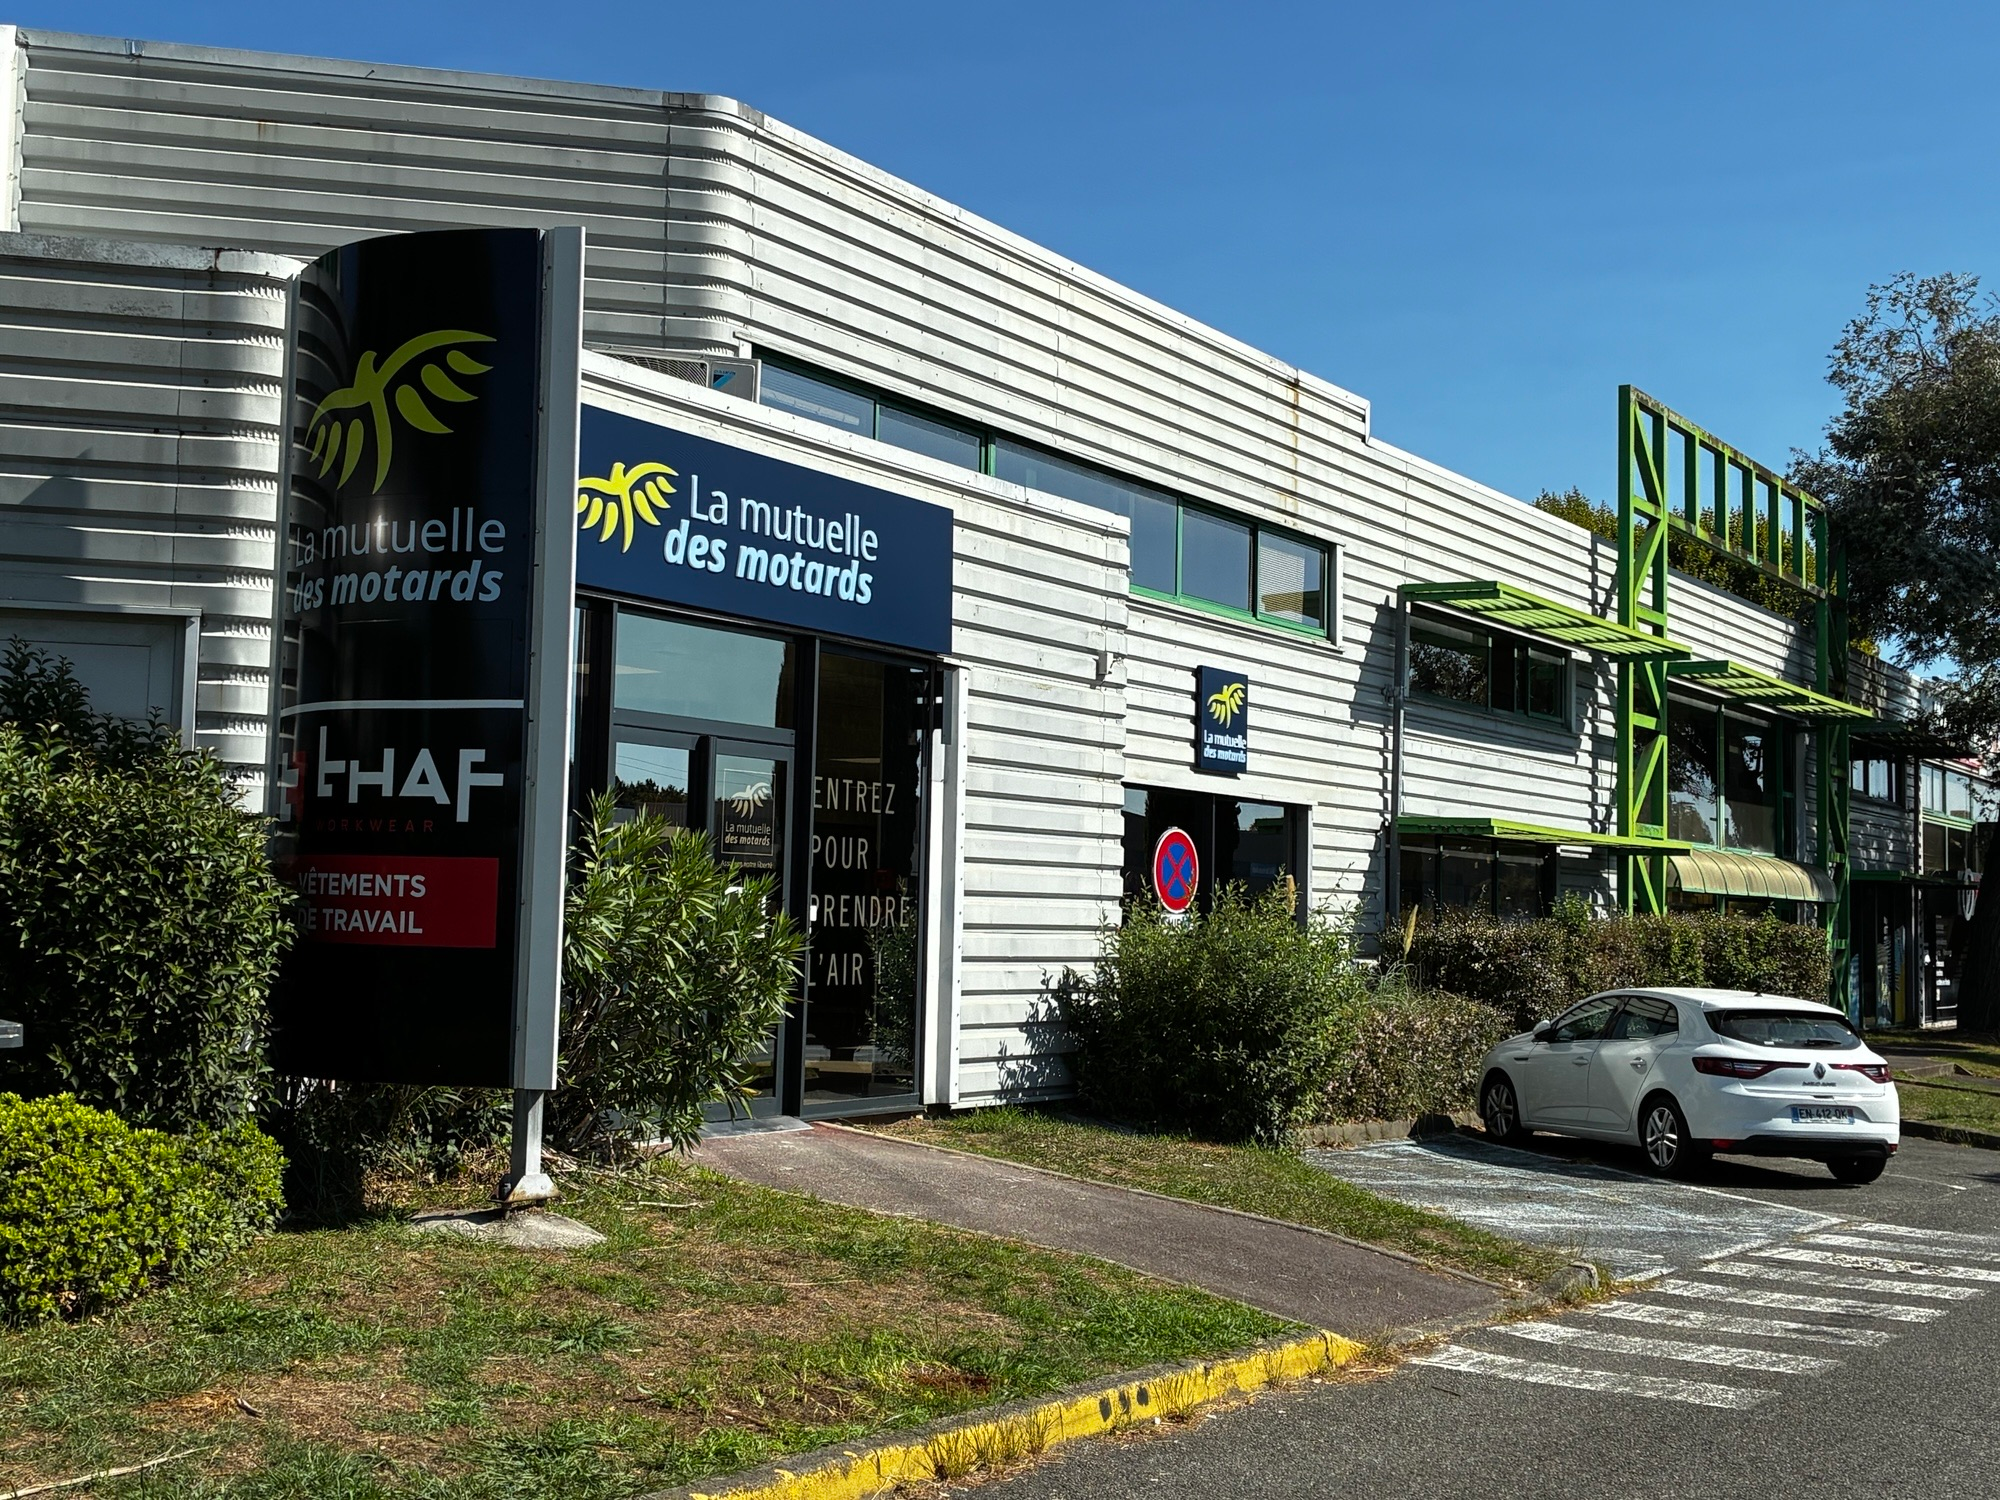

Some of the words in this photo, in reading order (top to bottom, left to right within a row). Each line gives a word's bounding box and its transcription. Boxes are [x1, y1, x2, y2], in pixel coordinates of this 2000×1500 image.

[690, 474, 729, 527] La
[740, 497, 879, 562] mutuelle
[295, 527, 315, 568] La
[322, 507, 506, 560] mutuelle
[663, 518, 728, 573] des
[735, 544, 875, 606] motards
[293, 571, 325, 613] des
[330, 559, 504, 606] motards
[1203, 729, 1214, 744] La
[1214, 734, 1247, 750] mutuelle
[1203, 744, 1217, 759] des
[1217, 749, 1246, 763] motards
[813, 776, 896, 815] ENTREZ
[724, 833, 738, 844] des
[739, 835, 771, 847] motards
[725, 821, 735, 833] La
[736, 823, 771, 835] mutuelle
[811, 835, 869, 869] POUR
[298, 866, 427, 898] VÊTEMENTS
[297, 907, 318, 930] DE
[322, 908, 424, 934] TRAVAIL
[806, 952, 864, 987] L'AIR
